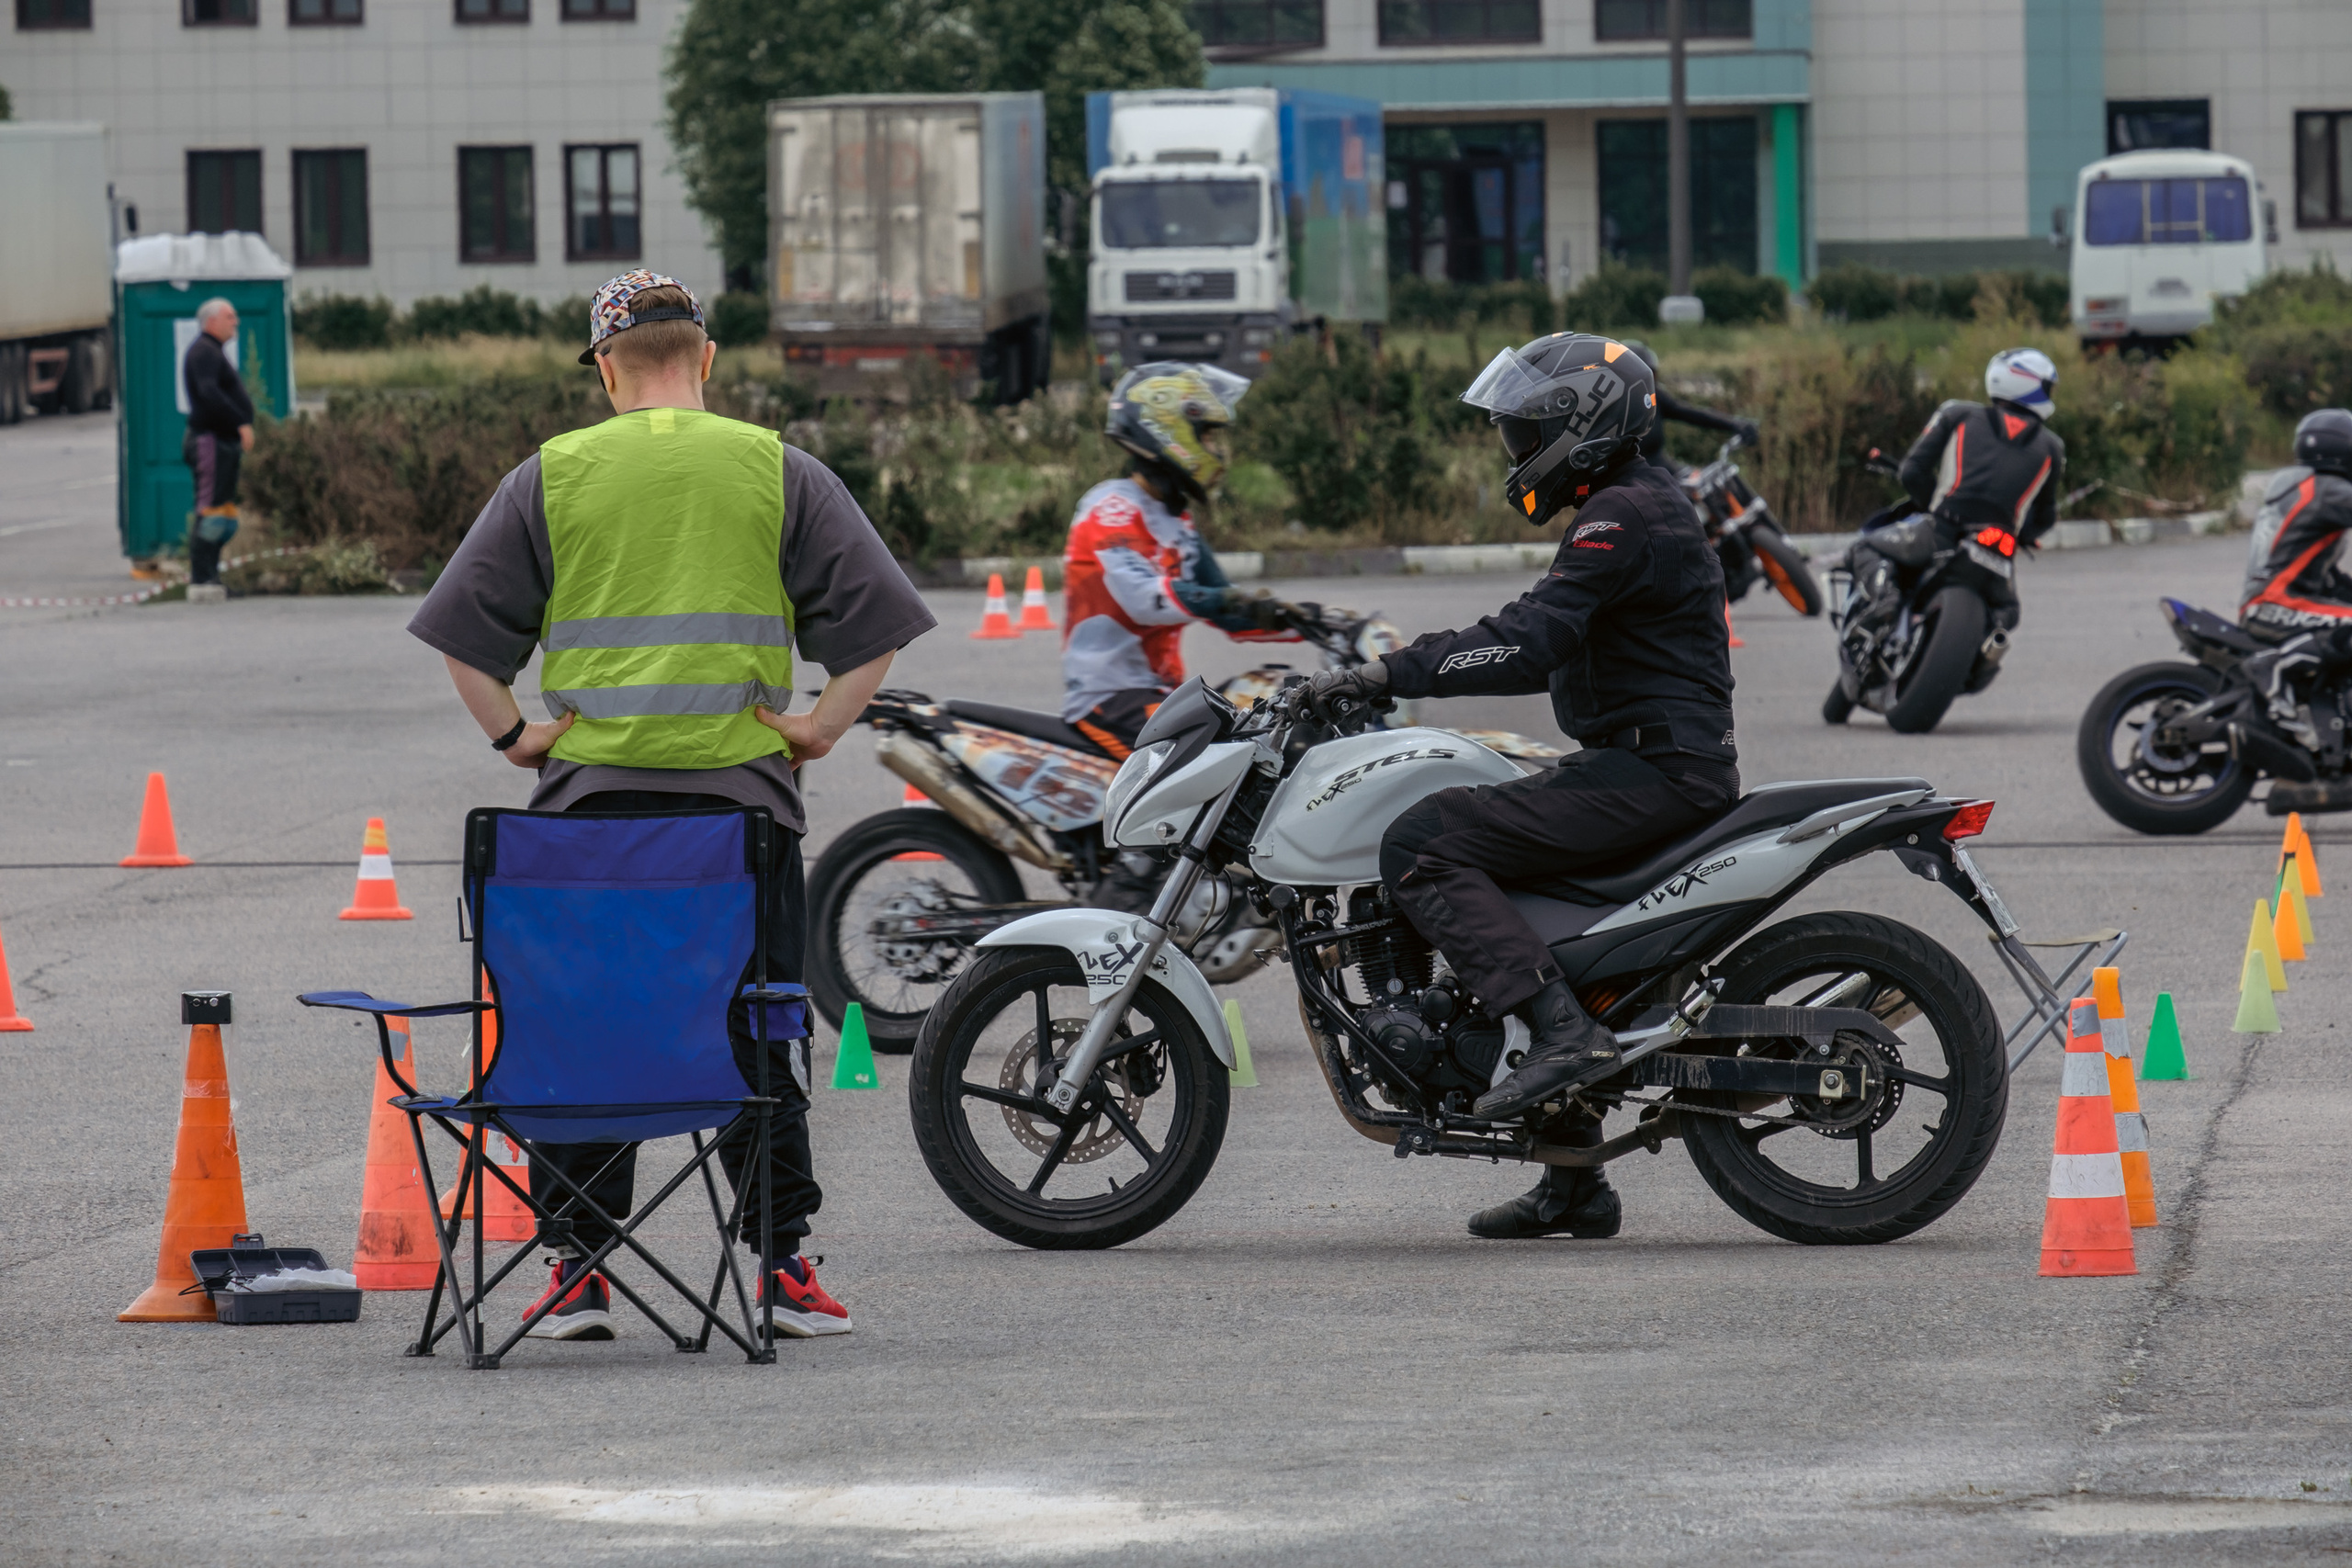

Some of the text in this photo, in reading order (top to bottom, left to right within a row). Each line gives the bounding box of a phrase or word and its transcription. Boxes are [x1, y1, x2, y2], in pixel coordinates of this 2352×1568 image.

[1566, 373, 1616, 438] HJC
[1572, 521, 1622, 542] RST
[1572, 539, 1614, 551] Blade
[1438, 646, 1521, 674] RST
[1334, 748, 1458, 783] STELS
[1340, 778, 1363, 790] 250
[1638, 856, 1737, 911] FLEX 250
